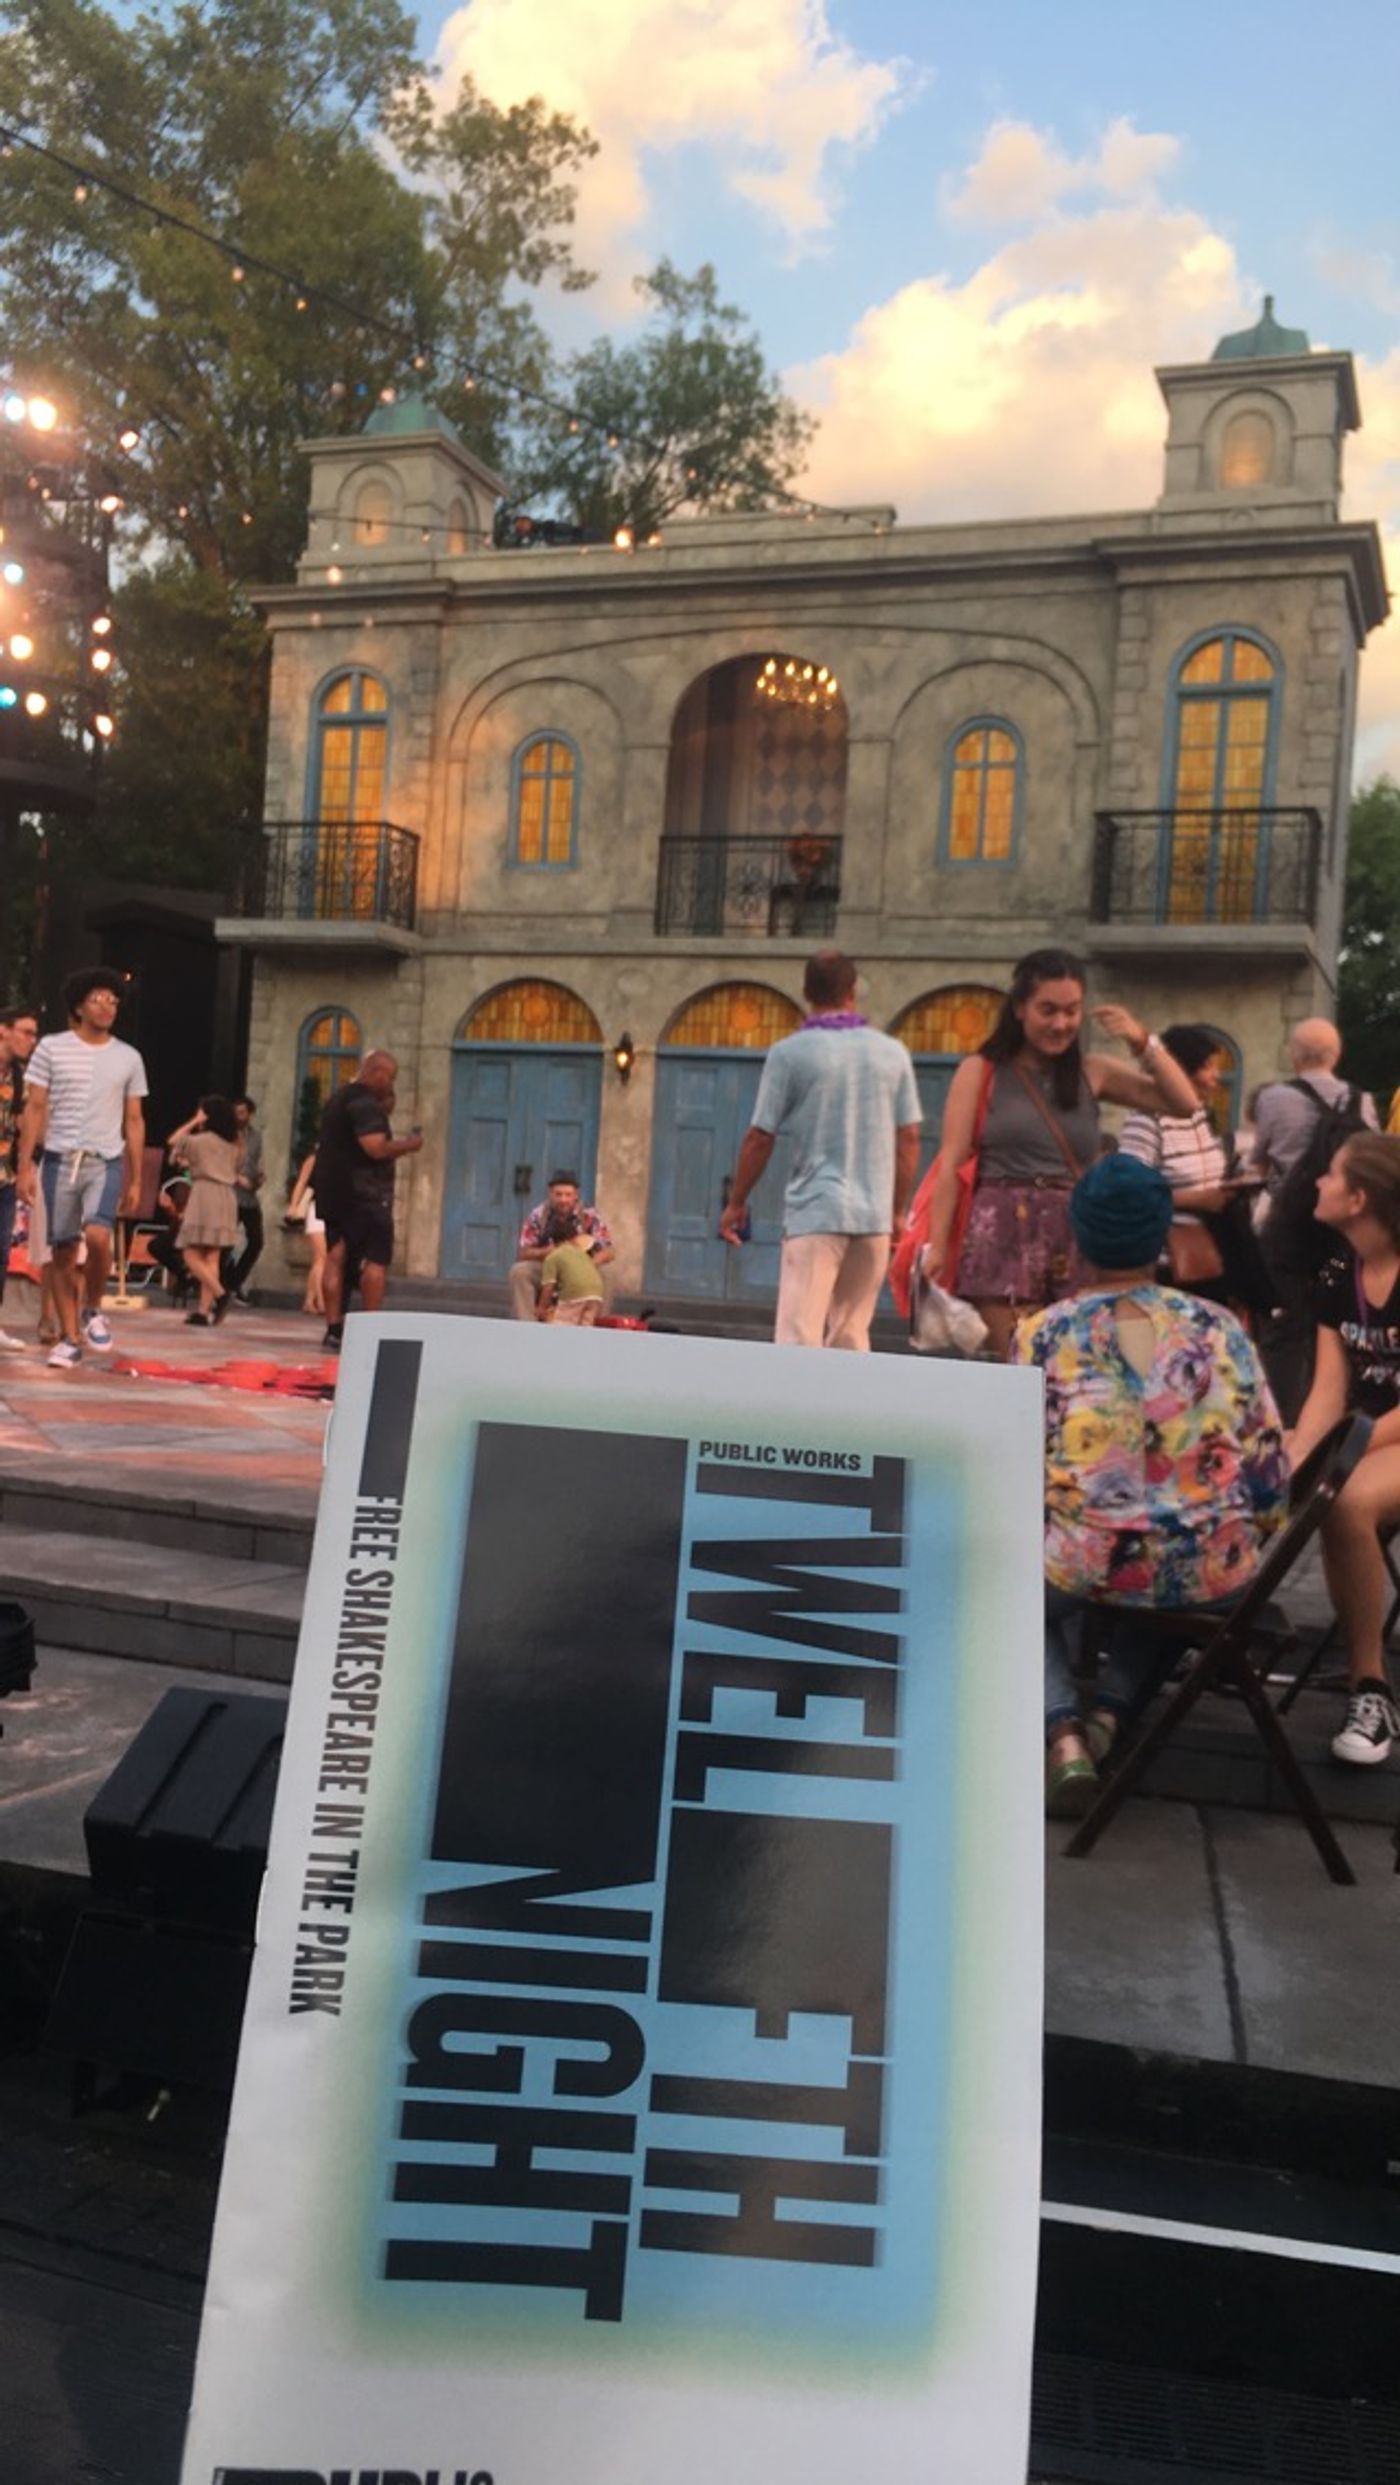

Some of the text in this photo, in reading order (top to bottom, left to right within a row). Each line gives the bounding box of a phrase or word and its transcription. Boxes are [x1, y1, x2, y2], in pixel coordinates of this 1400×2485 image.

[699, 1441, 861, 1471] PUBLIC WORKS
[318, 1568, 394, 1794] SHAKESPEARE
[311, 1803, 365, 1839] IN
[301, 1850, 359, 1914] THE
[289, 1923, 349, 2016] PARK
